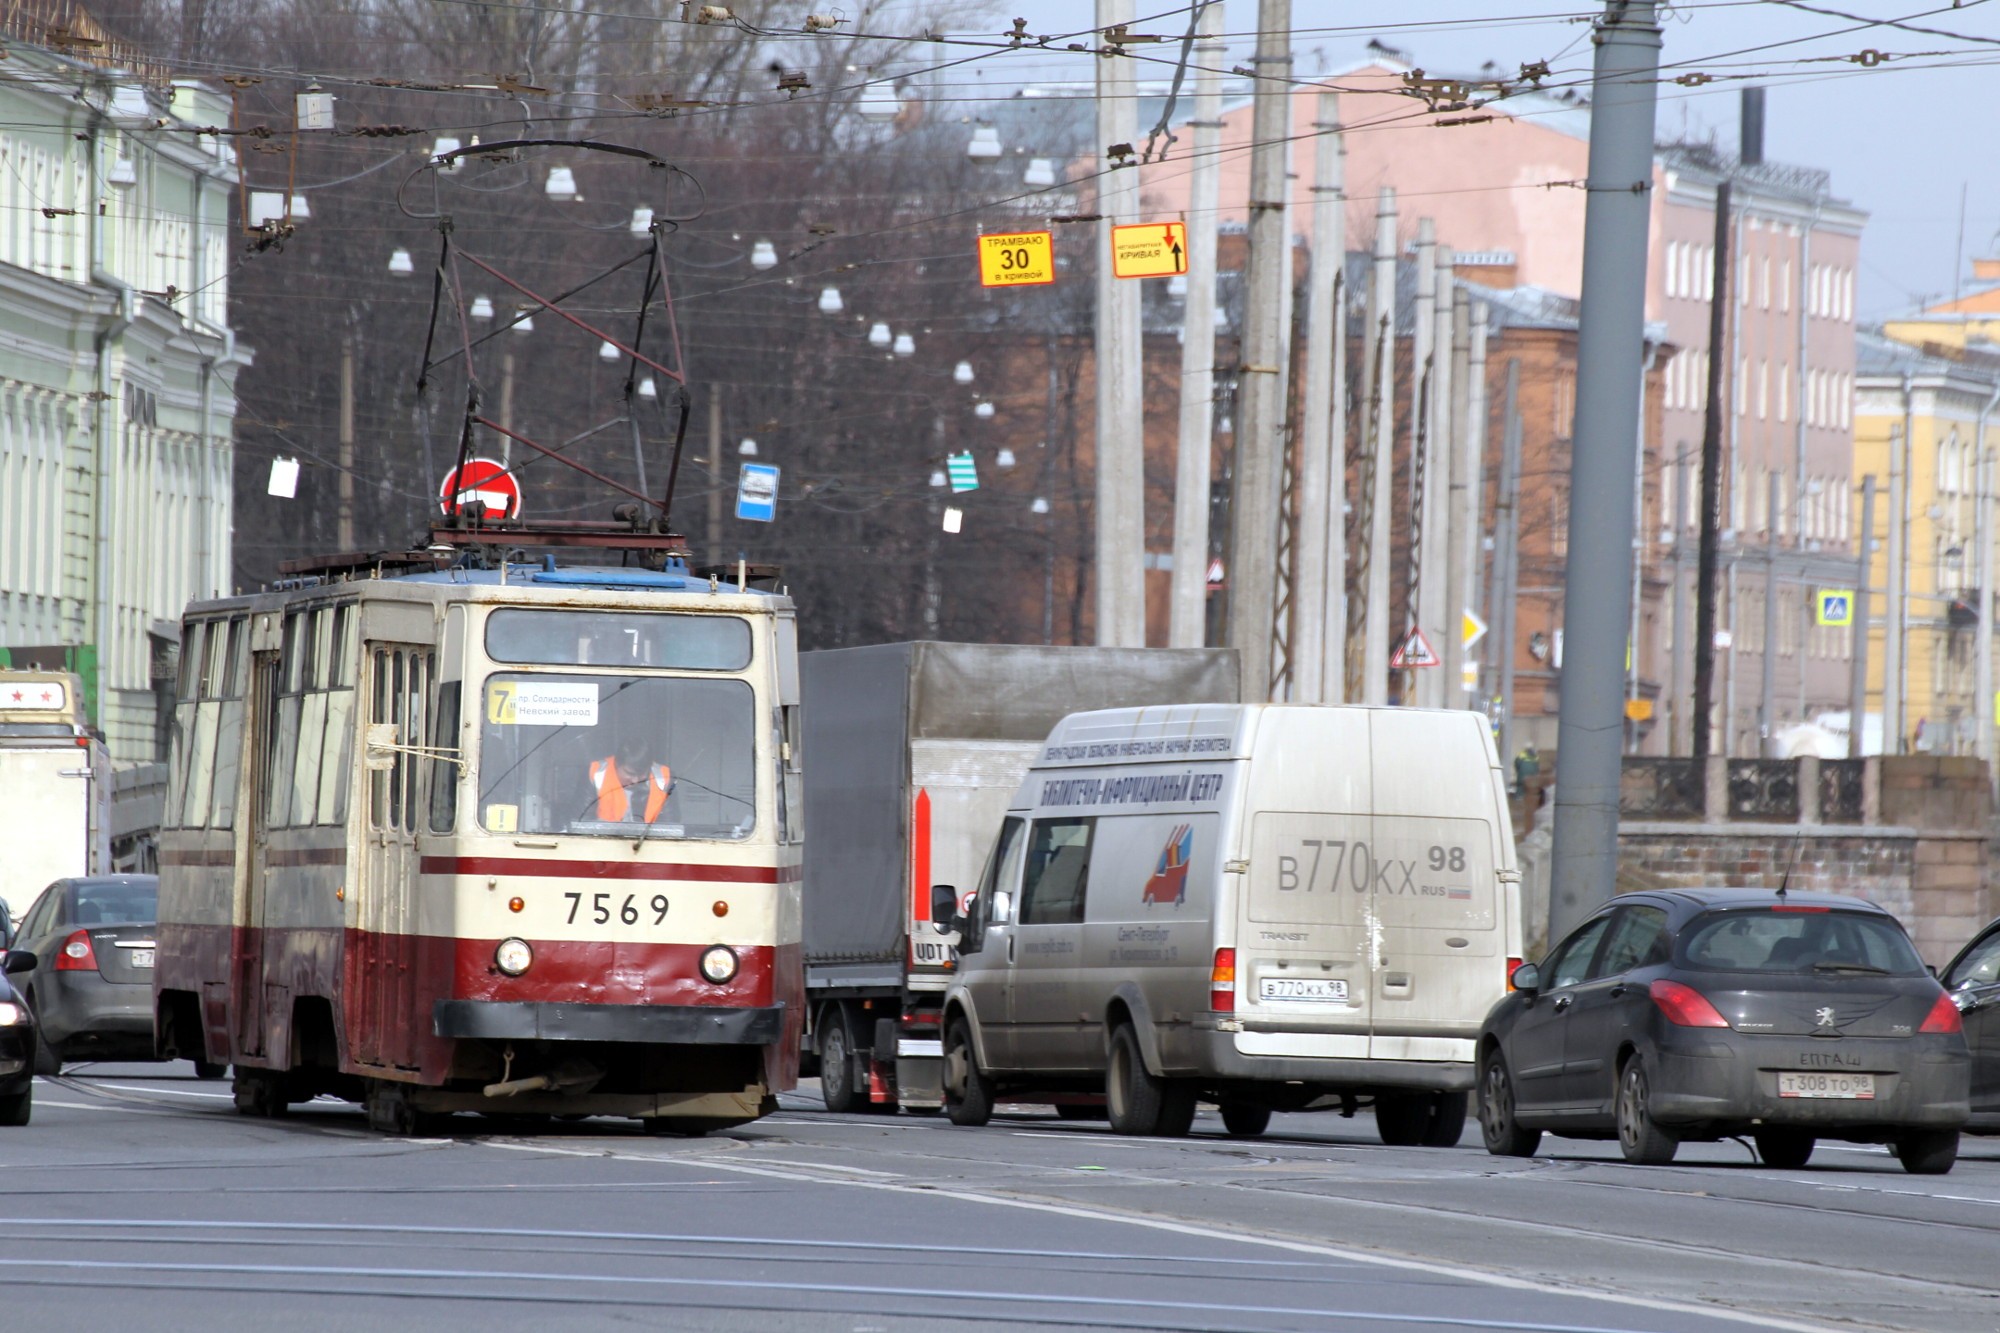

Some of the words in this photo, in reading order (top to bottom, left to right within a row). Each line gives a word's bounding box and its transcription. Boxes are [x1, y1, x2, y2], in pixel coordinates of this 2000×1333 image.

[987, 236, 1044, 248] ТРАМВАЮ
[1001, 248, 1029, 270] 30
[1120, 249, 1160, 260] КРИВАЯ
[623, 629, 639, 658] 7
[494, 690, 509, 718] 7
[532, 694, 590, 704] Солидарности
[519, 707, 559, 715] Невский
[562, 708, 591, 717] завод
[1040, 769, 1193, 807] БИБЛИОТЕЧНО-ИНФОРМАЦИОННЫЙ
[1190, 774, 1223, 805] ЦЕНТР
[1428, 845, 1466, 873] 98
[1420, 885, 1446, 896] RUS
[564, 892, 670, 926] 7569
[1259, 931, 1310, 941] TRANSIT
[916, 943, 943, 960] UDT
[1328, 982, 1342, 993] 98
[1853, 1075, 1869, 1088] 98
